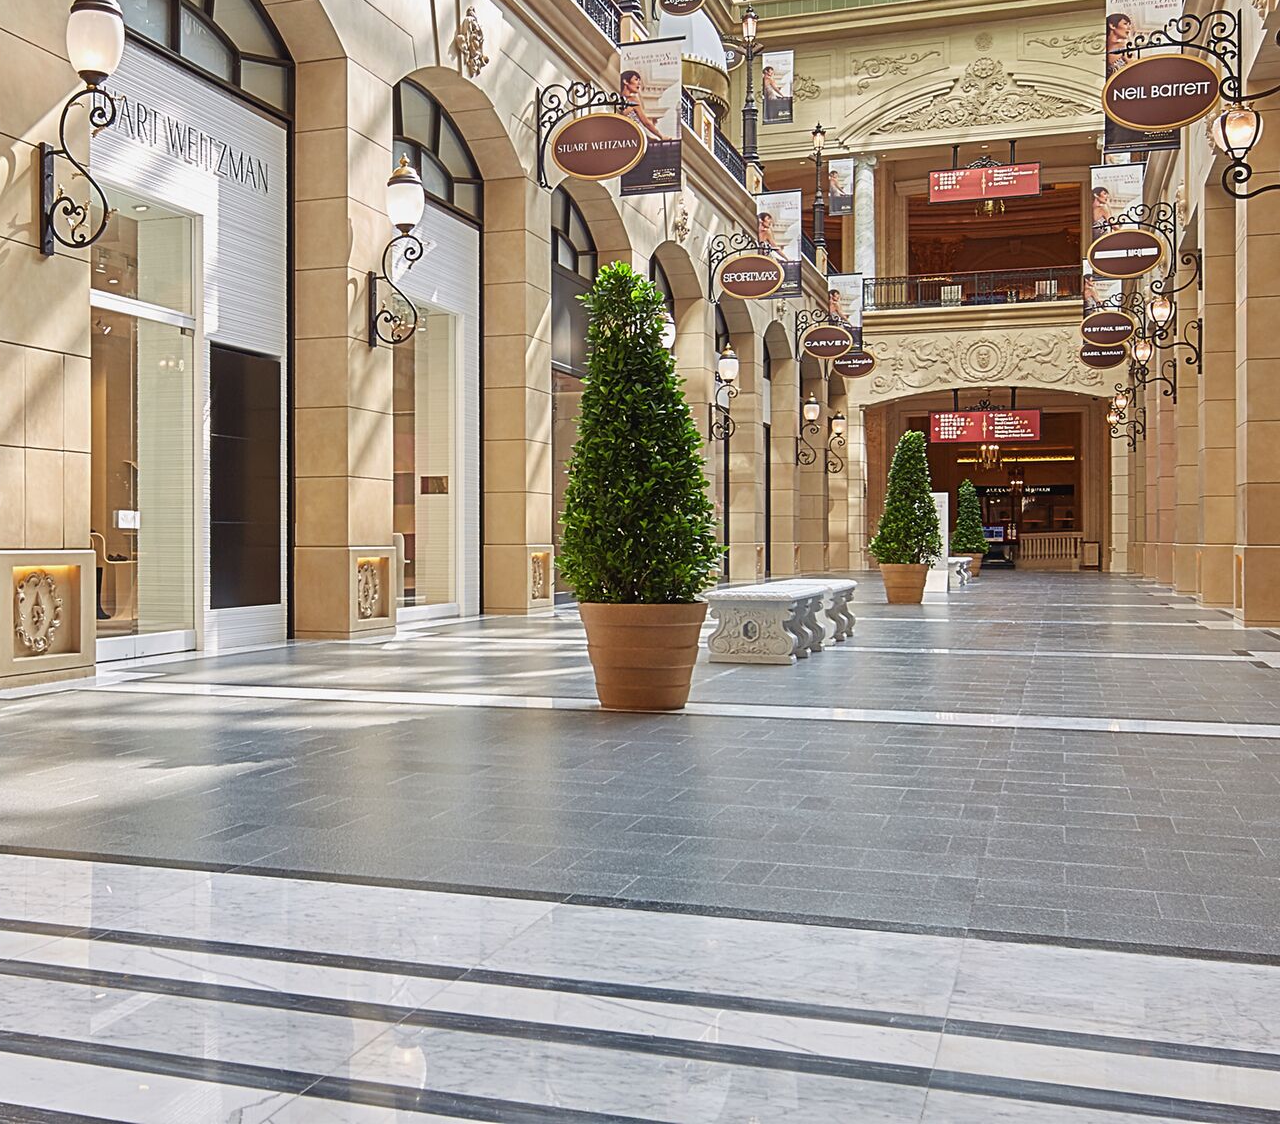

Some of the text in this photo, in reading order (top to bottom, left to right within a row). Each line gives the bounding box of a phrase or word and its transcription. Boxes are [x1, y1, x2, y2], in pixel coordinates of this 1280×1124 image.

[557, 139, 638, 154] STUART WEITZMAN
[165, 115, 270, 195] WEITZMAN
[723, 271, 778, 283] SPORTMAX
